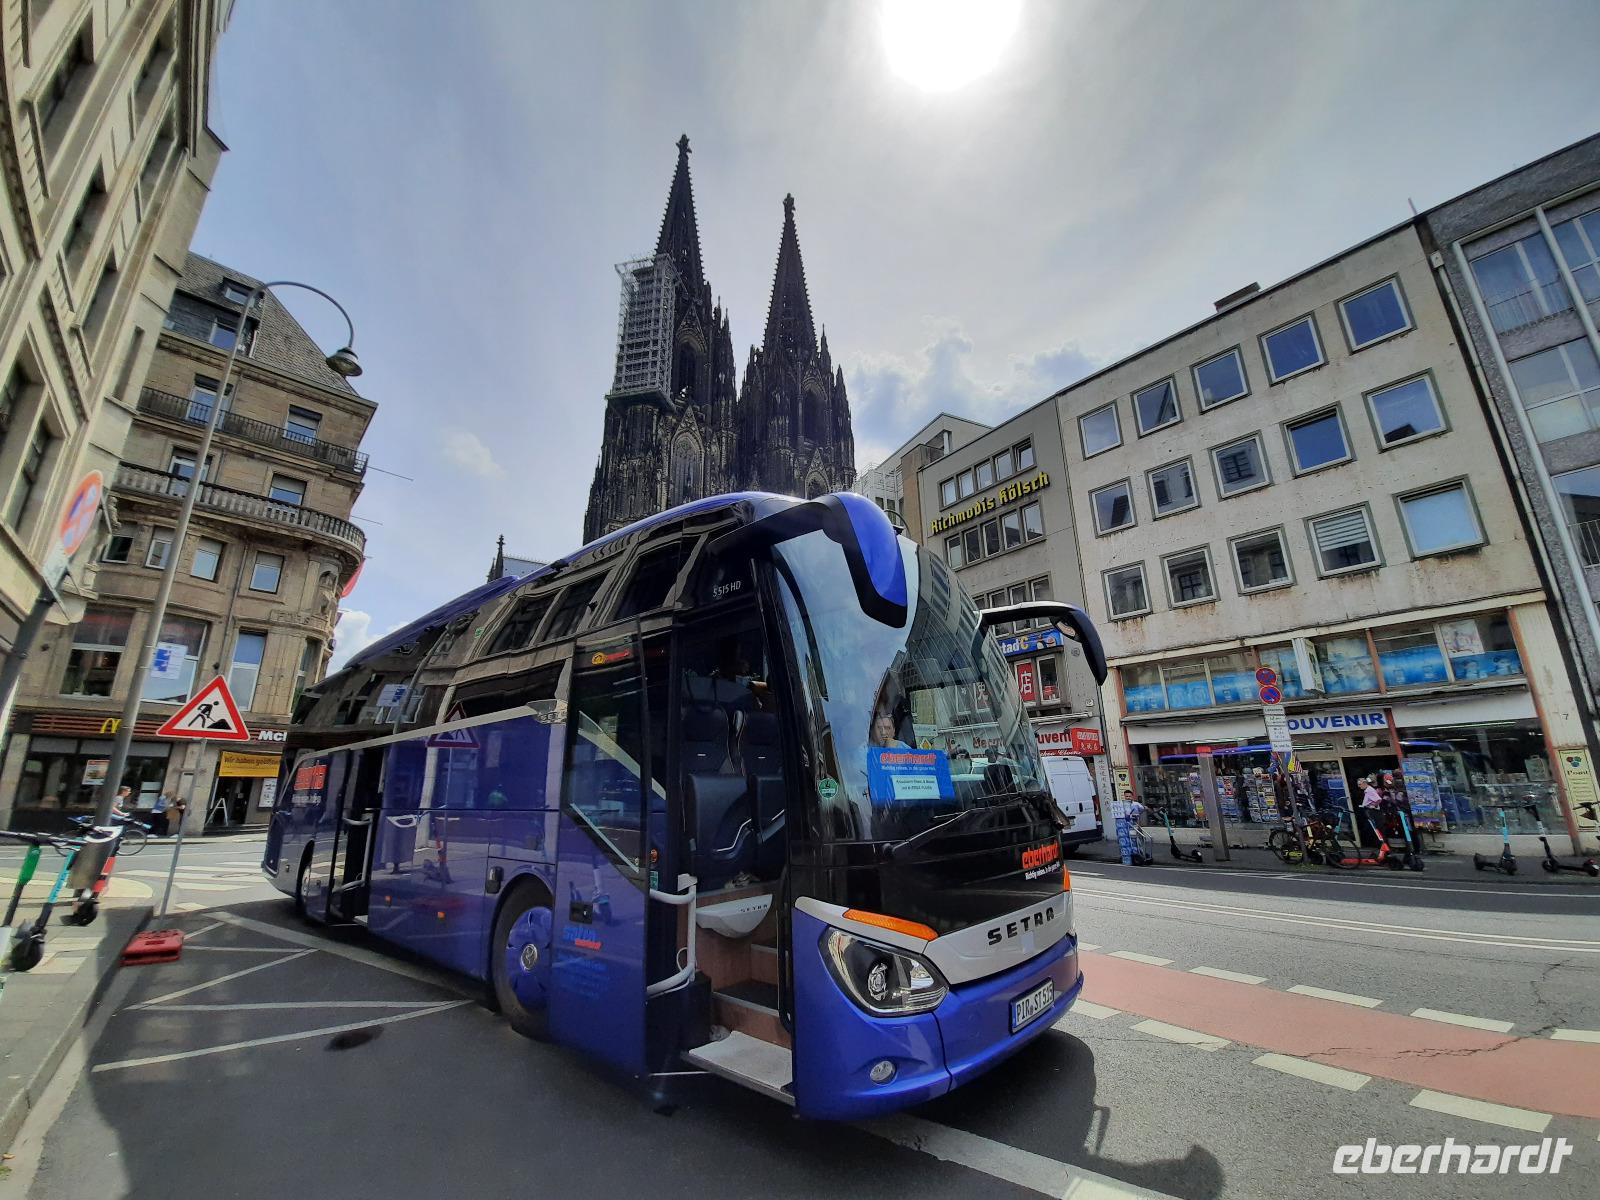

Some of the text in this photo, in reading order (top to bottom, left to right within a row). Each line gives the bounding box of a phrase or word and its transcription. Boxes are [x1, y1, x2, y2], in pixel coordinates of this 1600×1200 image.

[930, 471, 1049, 534] Richmodis Kölsch
[1287, 713, 1386, 731] OUVENIR
[987, 906, 1055, 946] SETRA
[1016, 984, 1054, 1022] PIR ST 515
